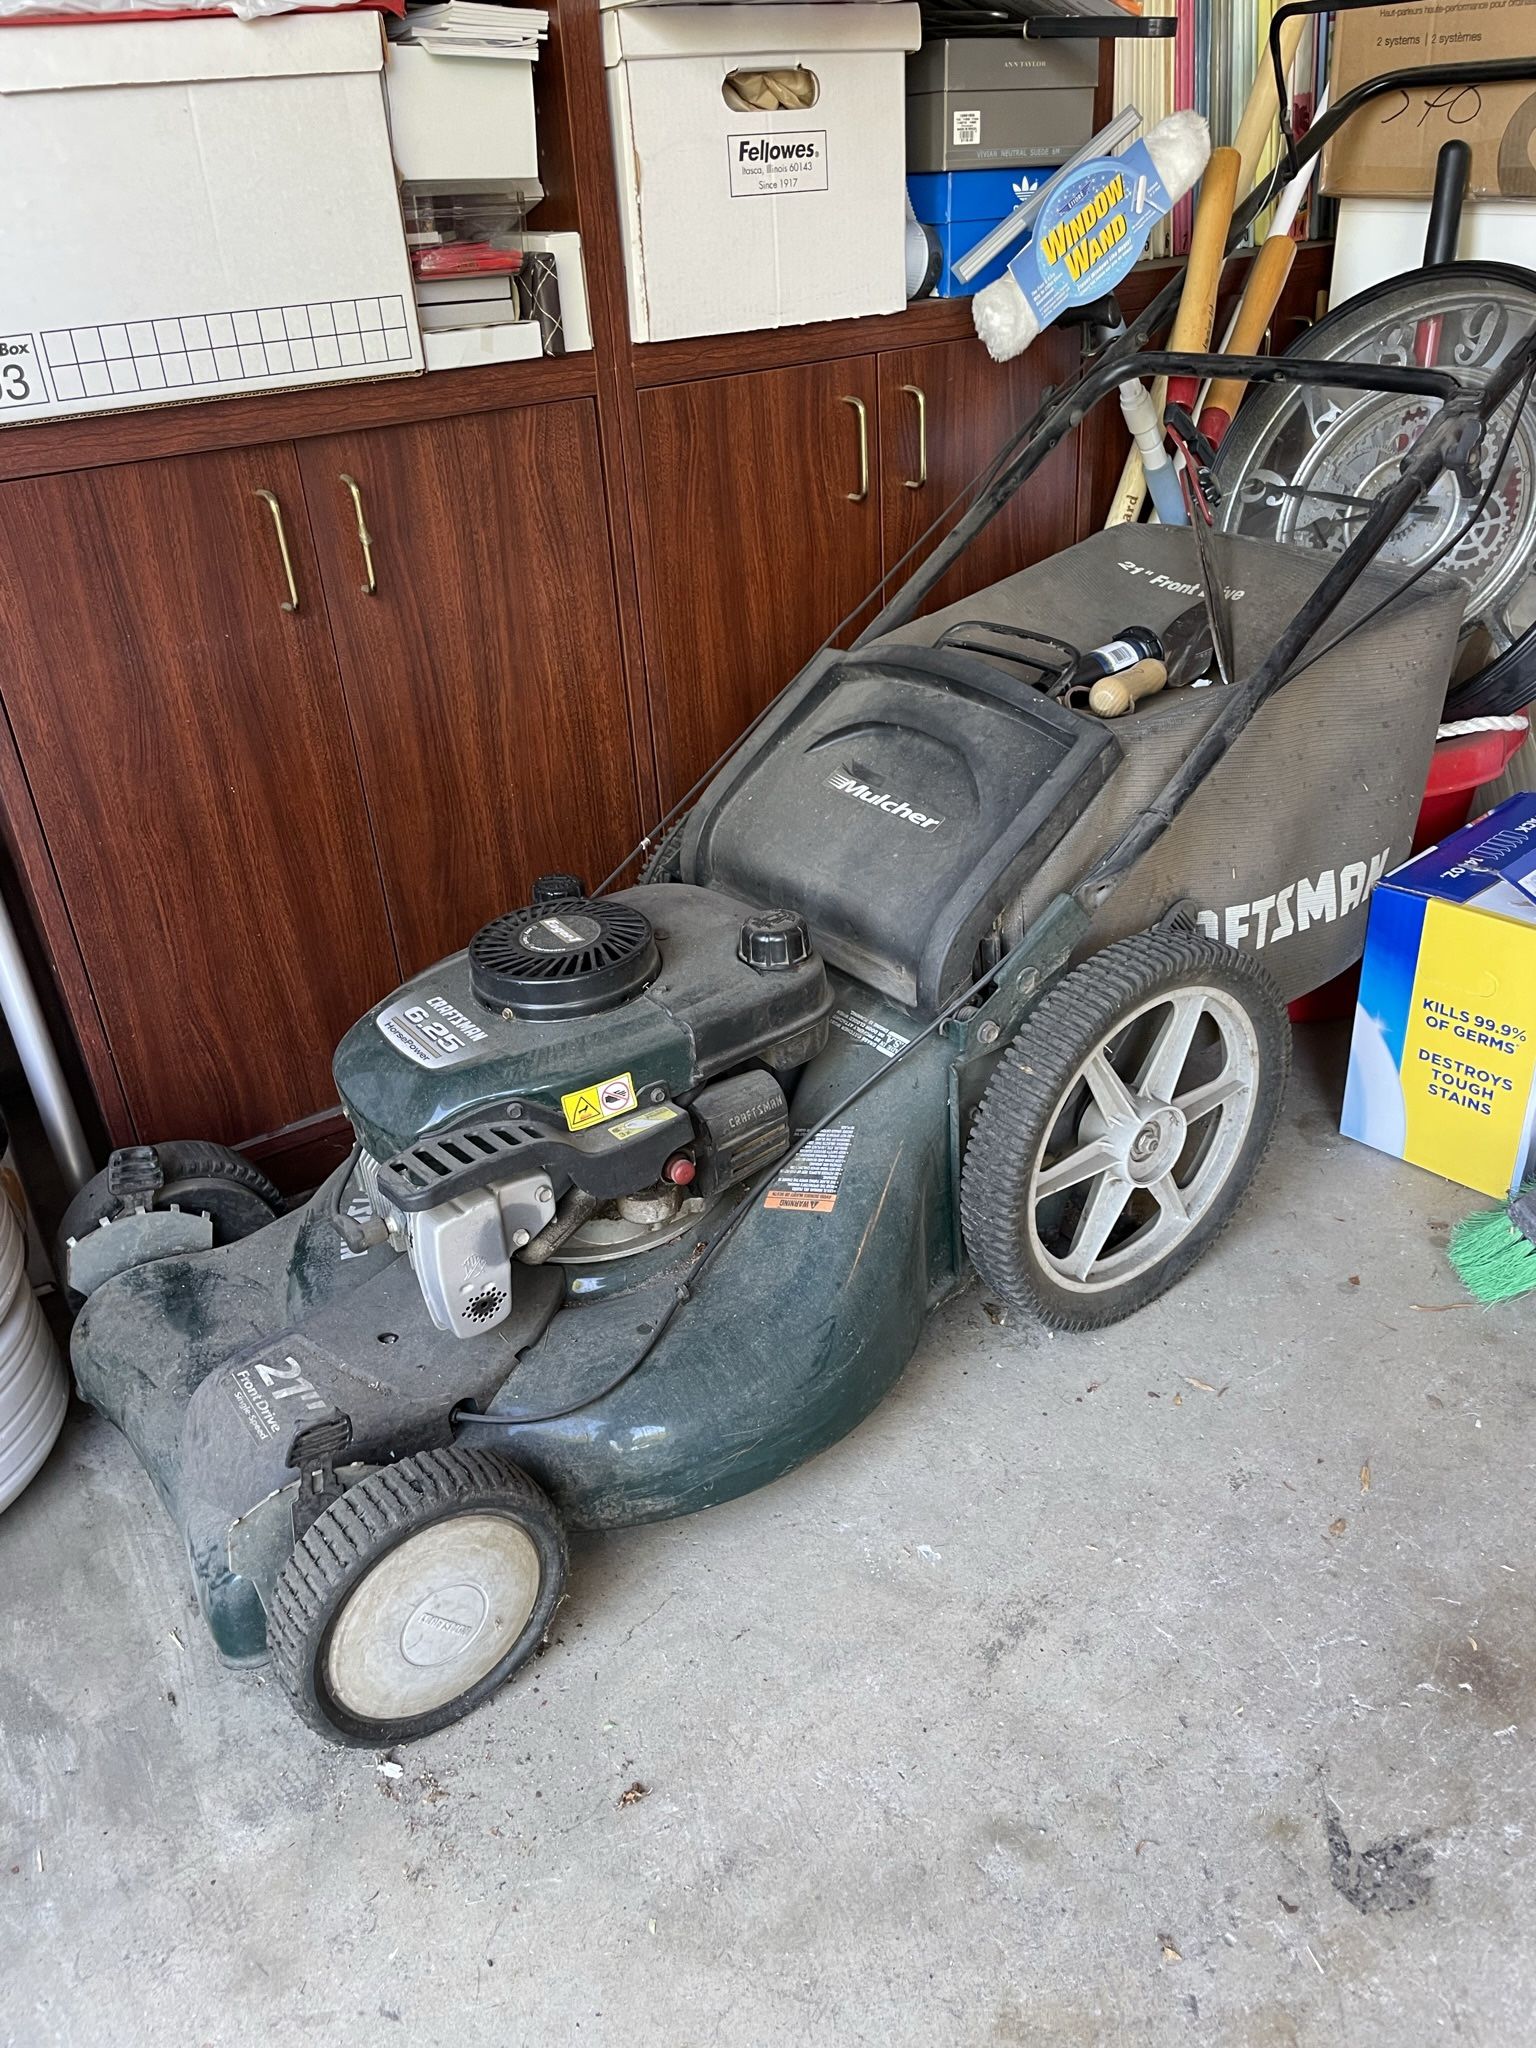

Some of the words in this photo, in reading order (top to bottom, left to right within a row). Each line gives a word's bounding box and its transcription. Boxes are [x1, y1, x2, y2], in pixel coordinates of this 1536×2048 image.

[1376, 36, 1383, 47] 2
[1384, 35, 1420, 48] systems
[1431, 33, 1437, 44] 2
[1438, 31, 1482, 45] systèmes
[1020, 60, 1046, 68] TAYLOR
[738, 139, 815, 163] Fellowes
[766, 163, 788, 174] Illinois
[789, 161, 813, 173] 60143
[1000, 147, 1028, 158] NEUTRAL
[758, 180, 778, 190] Since
[780, 177, 798, 189] 1917
[1040, 173, 1125, 266] WINDOW
[1064, 213, 1128, 282] WAND
[0, 343, 30, 356] Box
[0, 364, 30, 400] 3
[1149, 574, 1201, 597] Front
[843, 780, 940, 828] Mulcher
[403, 1006, 466, 1054] 6.25
[425, 996, 489, 1042] CRAFTSMAN
[1422, 998, 1470, 1023] KILLS
[1473, 1015, 1527, 1042] 99.9%
[1425, 1015, 1449, 1031] OF
[1453, 1025, 1515, 1054] GERMS
[1418, 1048, 1513, 1091] DESTROYS
[1431, 1068, 1494, 1101] TOUGH
[728, 1095, 783, 1128] CRAFTSMAN
[1427, 1083, 1491, 1115] STAINS
[779, 1199, 810, 1208] WARNING
[233, 1390, 269, 1441] Single-Speed
[236, 1369, 261, 1401] Front
[255, 1396, 281, 1433] Drive
